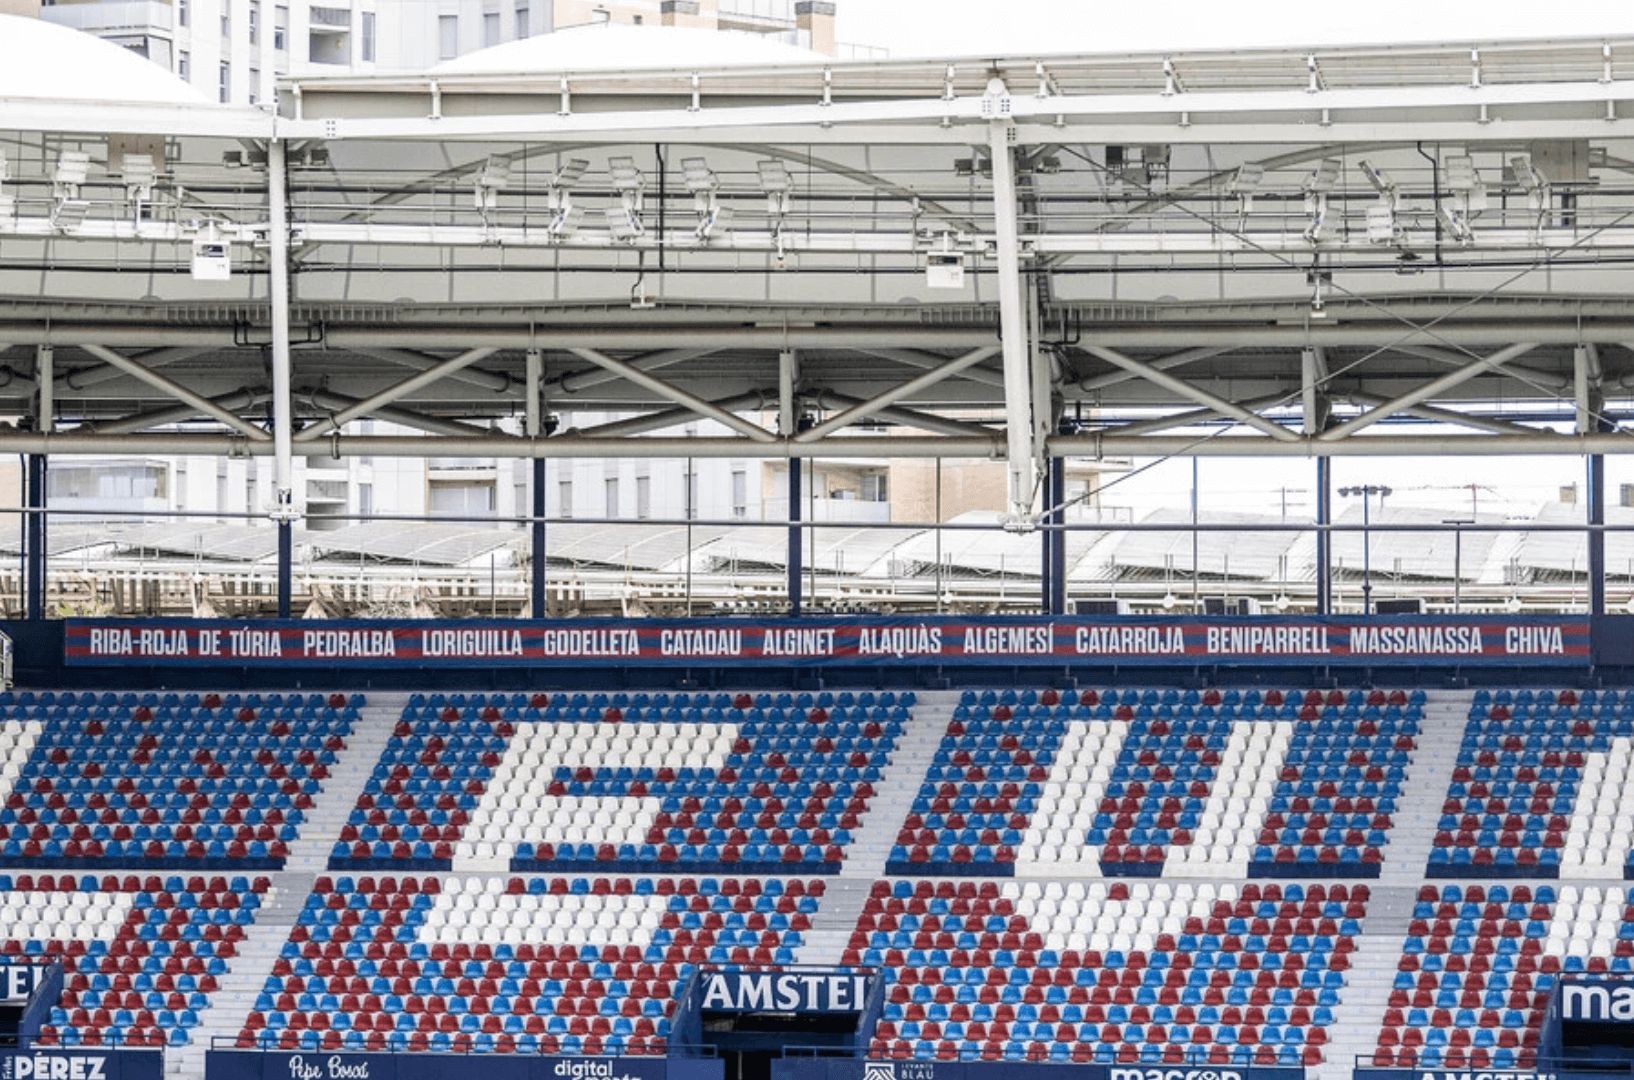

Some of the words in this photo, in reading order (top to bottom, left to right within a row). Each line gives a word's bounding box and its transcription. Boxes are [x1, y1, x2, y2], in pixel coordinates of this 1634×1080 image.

[90, 628, 188, 655] RIBA-ROJA
[199, 630, 222, 655] DE
[229, 626, 281, 657] TÚRIA
[303, 630, 396, 657] PEDRALBA
[422, 630, 523, 656] LORIGUILLA
[544, 629, 640, 656] GODELLETA
[660, 629, 742, 655] CATADAU
[762, 628, 835, 656] ALGINET
[859, 623, 942, 658] ALAQUÀS
[963, 622, 1054, 654] ALGEMESÍ
[1075, 626, 1185, 654] CATARROJA
[1207, 626, 1330, 654] BENIPARRELL
[1350, 626, 1483, 654] MASSANASSA
[1505, 626, 1564, 654] CHIVA
[14, 1051, 106, 1079] PÉREZ
[554, 1060, 613, 1080] digital
